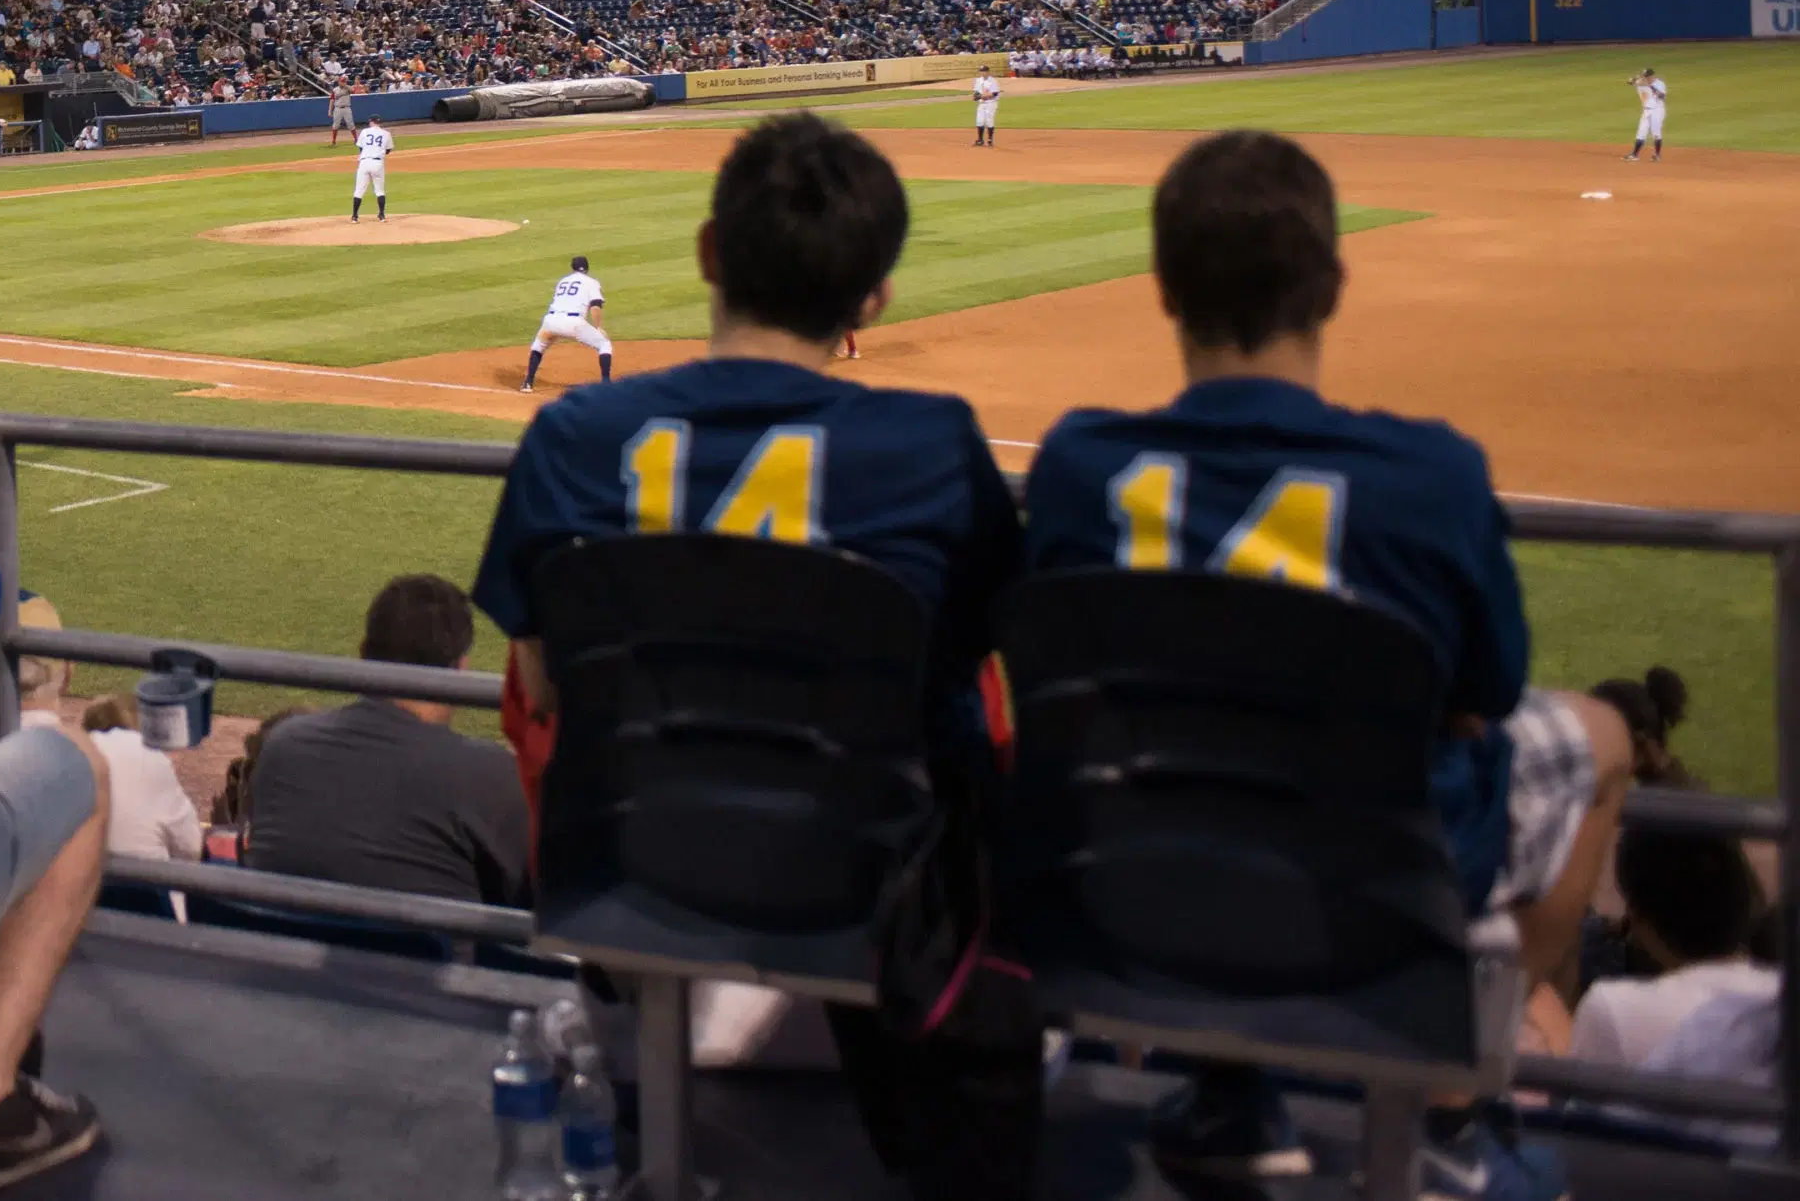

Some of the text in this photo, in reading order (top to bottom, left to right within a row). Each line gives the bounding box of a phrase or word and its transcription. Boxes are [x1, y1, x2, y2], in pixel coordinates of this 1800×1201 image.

[1771, 8, 1800, 33] U
[696, 79, 707, 89] For
[720, 78, 737, 87] Your
[768, 75, 782, 84] and
[366, 133, 383, 147] 34
[557, 281, 582, 296] 56
[620, 417, 829, 545] 14
[1106, 451, 1348, 590] 14
